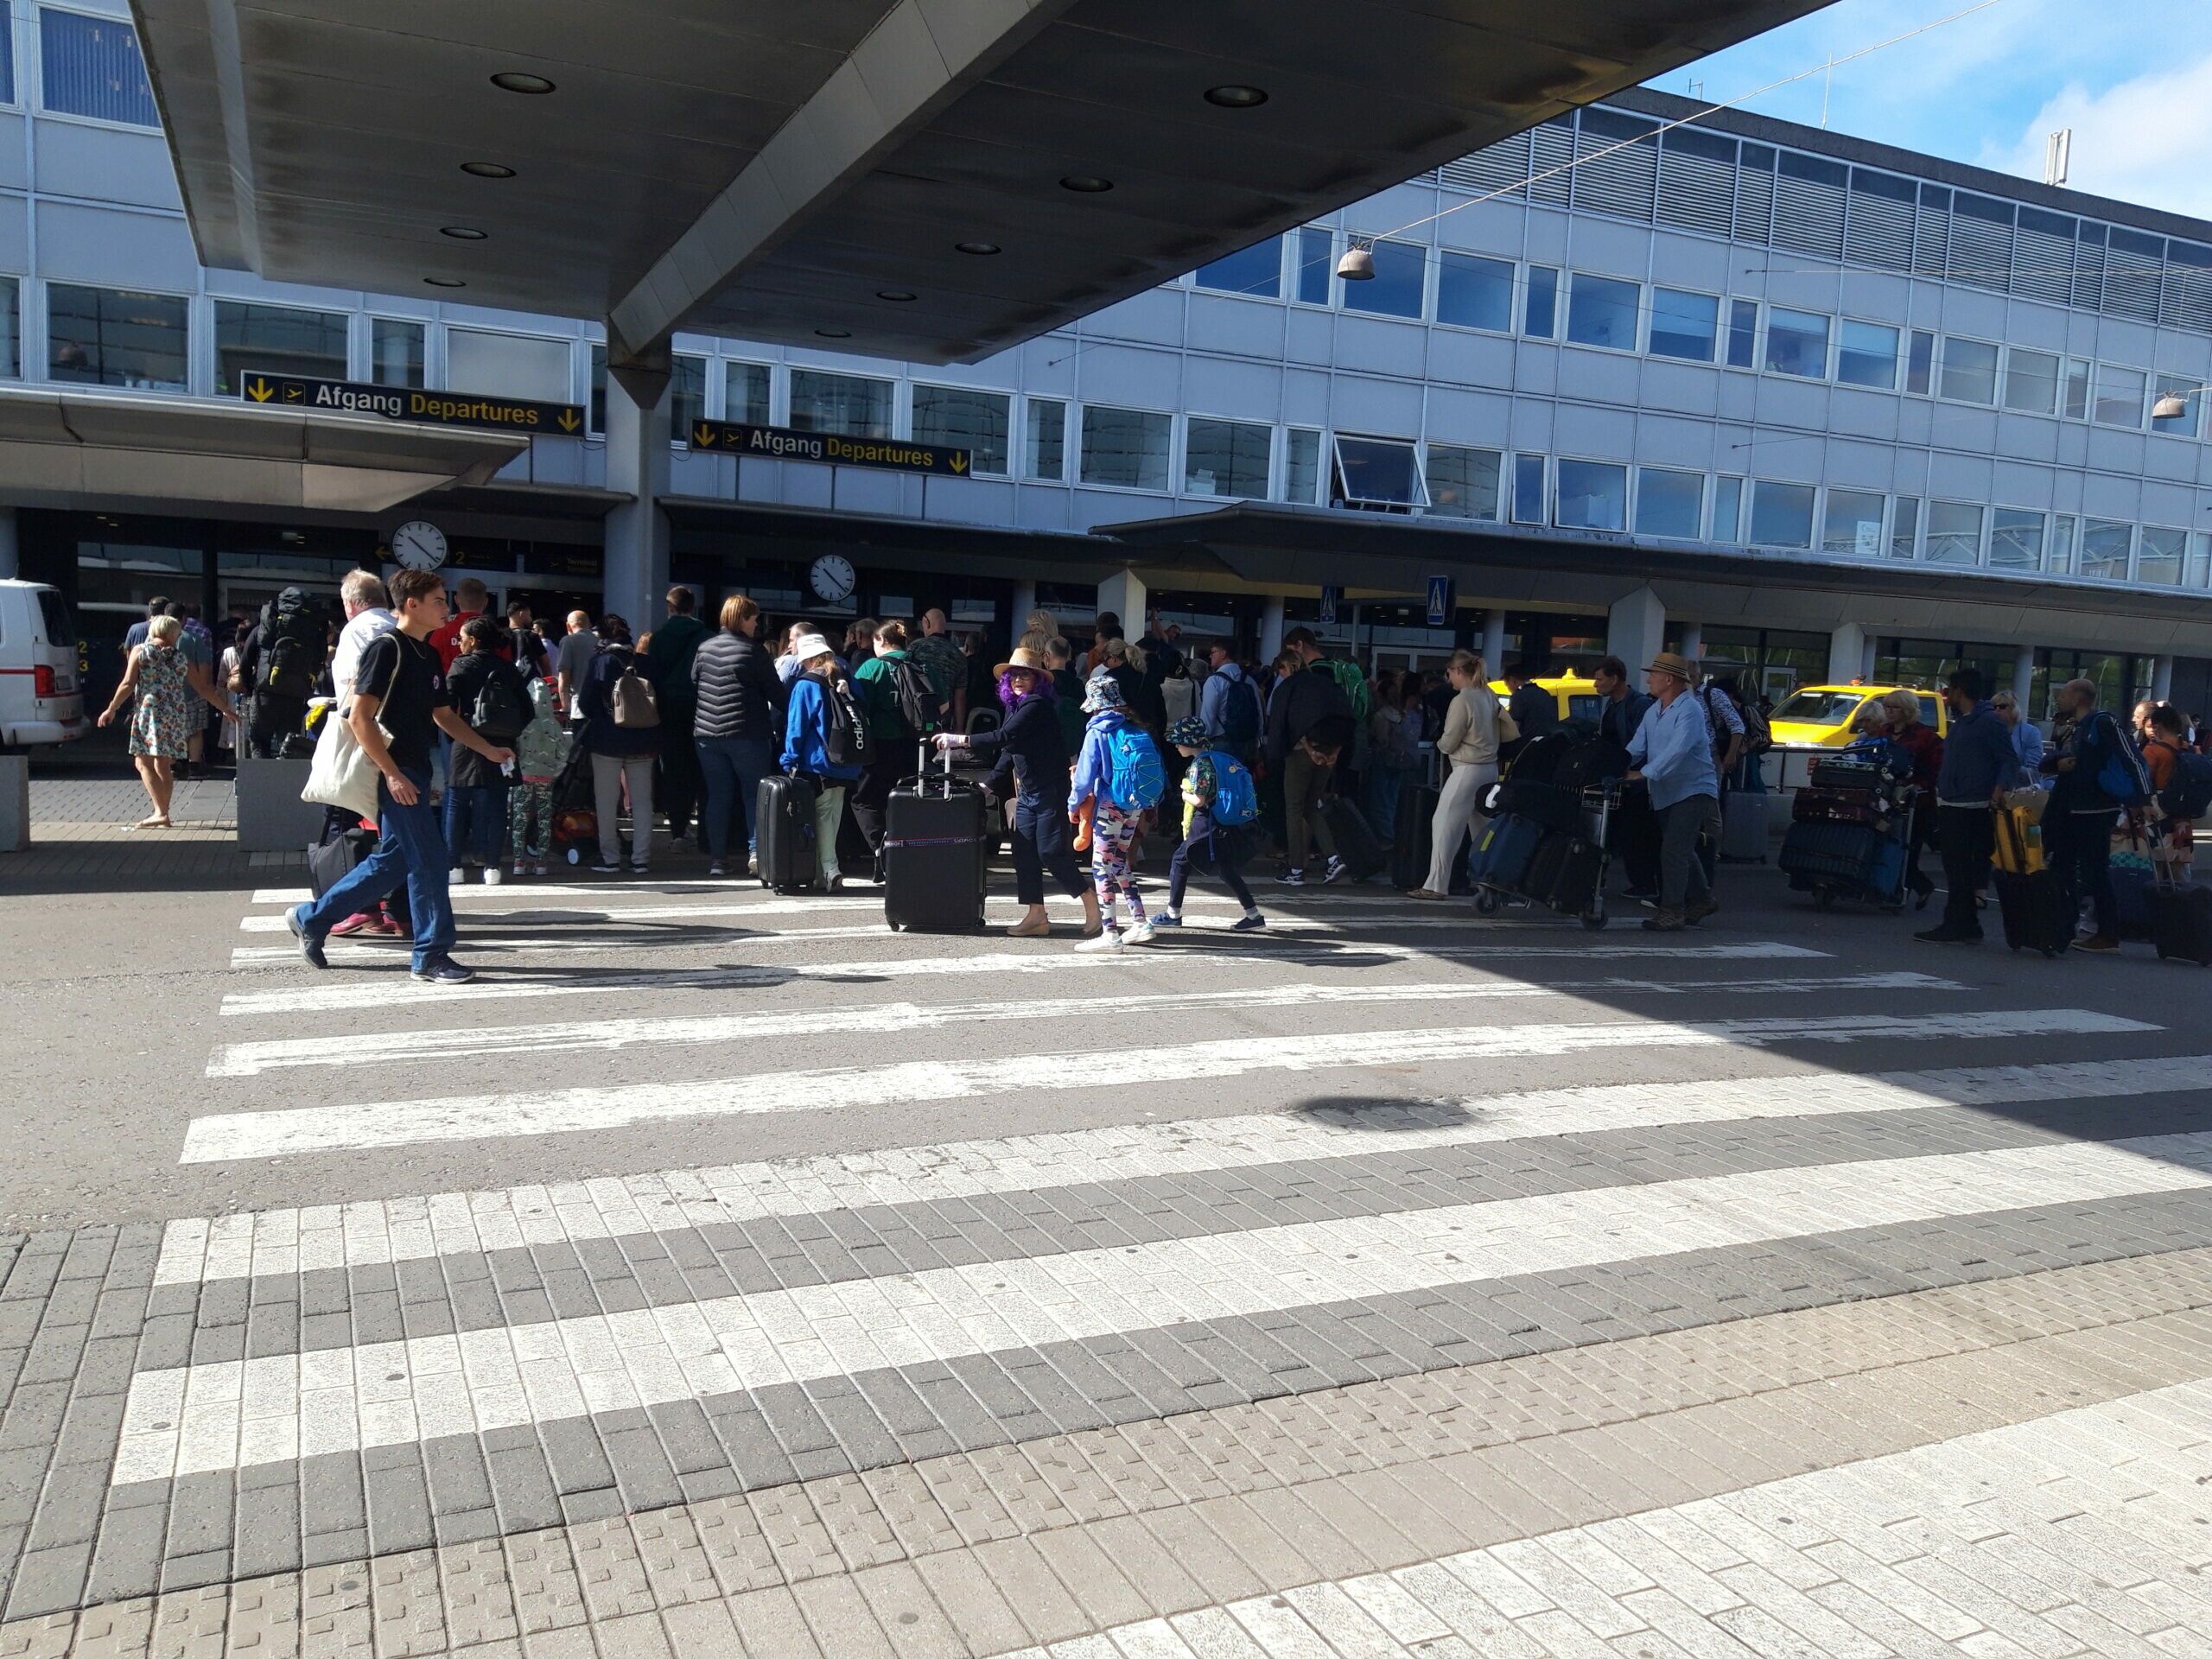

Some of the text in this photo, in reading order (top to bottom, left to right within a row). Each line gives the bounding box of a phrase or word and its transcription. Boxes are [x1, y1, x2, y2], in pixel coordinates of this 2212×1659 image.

[315, 385, 539, 425] Afgang Departures
[750, 429, 933, 467] Afgang Departures
[78, 640, 87, 654] 2
[79, 658, 89, 672] 3
[846, 705, 864, 750] adidas
